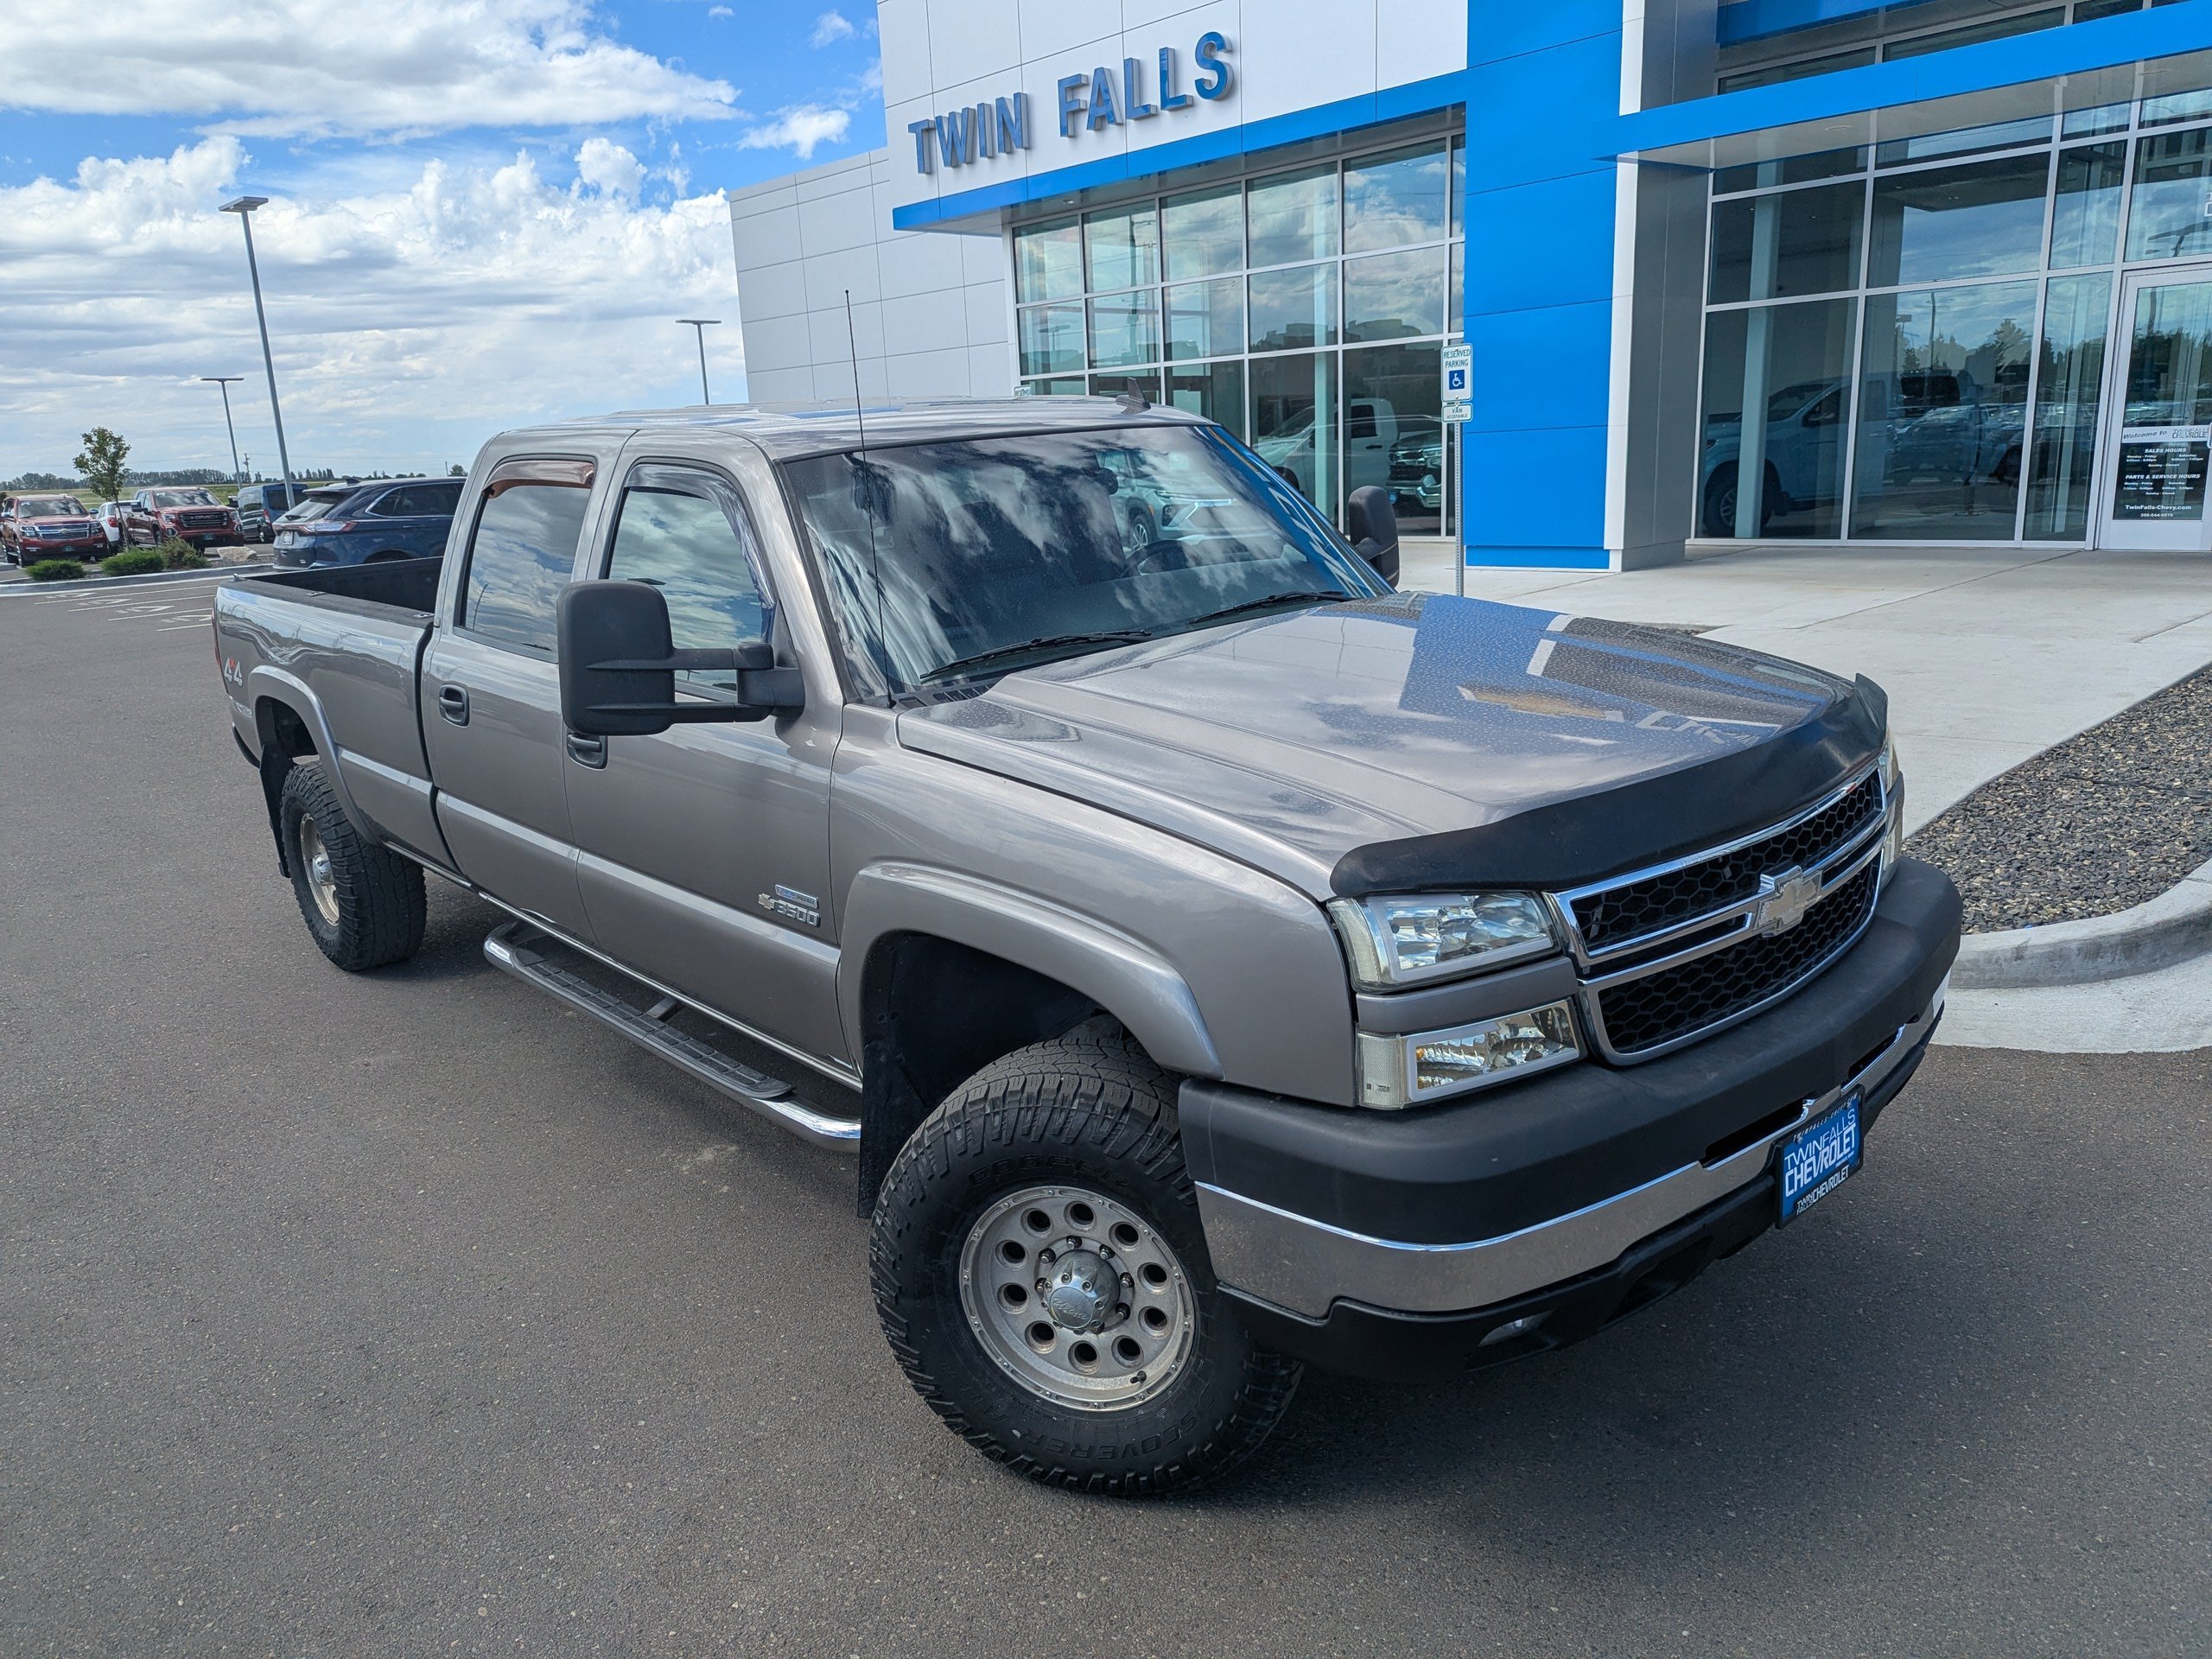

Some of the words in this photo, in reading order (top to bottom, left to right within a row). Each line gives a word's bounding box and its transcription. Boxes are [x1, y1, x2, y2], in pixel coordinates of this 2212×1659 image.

[908, 92, 1029, 174] TWIN
[1058, 31, 1234, 138] FALLS
[1443, 349, 1471, 359] RESERVED
[1445, 359, 1469, 368] PARKING
[1784, 1108, 1856, 1170] TWINFALLS
[1785, 1122, 1856, 1198] CHEVROLET
[1812, 1164, 1850, 1204] CHEVROLET
